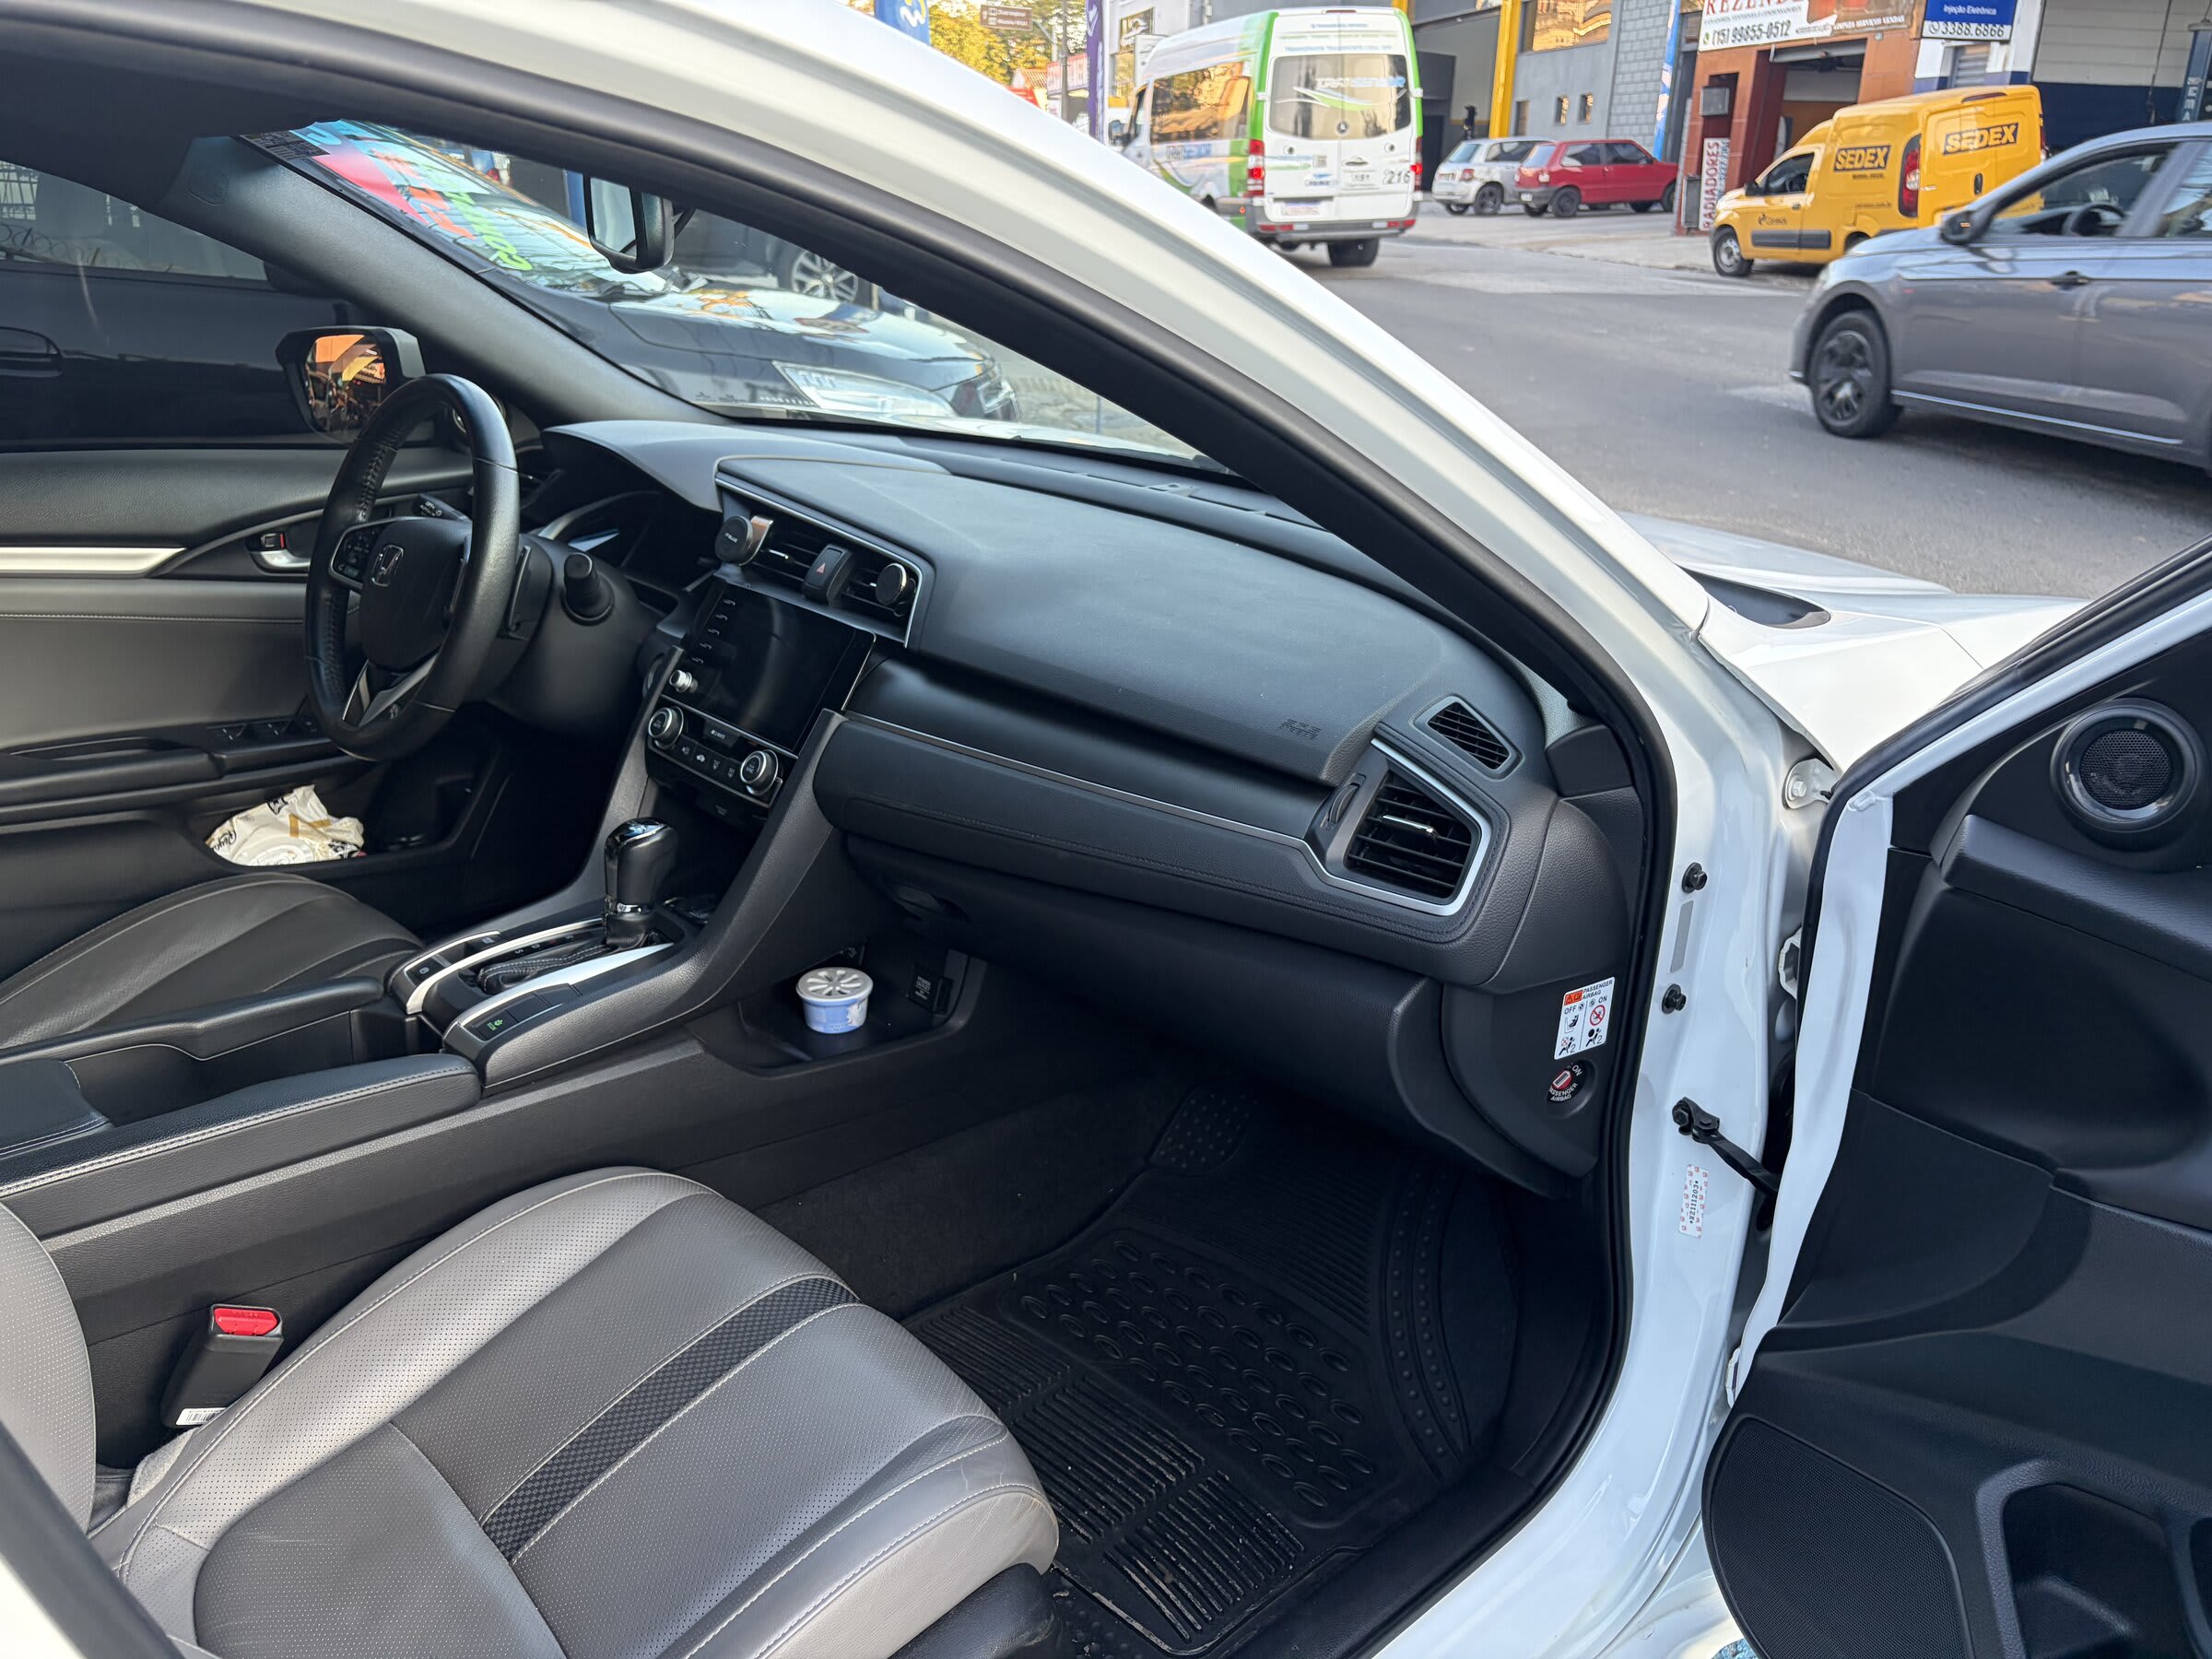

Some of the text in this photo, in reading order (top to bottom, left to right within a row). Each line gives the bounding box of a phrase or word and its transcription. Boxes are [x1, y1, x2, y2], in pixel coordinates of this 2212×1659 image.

[1946, 124, 2018, 152] SEDEX
[1836, 147, 1888, 170] SEDEX
[1583, 980, 1613, 993] PASSENGER
[1583, 990, 1602, 1000] AIRBAG
[1598, 995, 1607, 1004] ON
[1564, 1005, 1577, 1015] OFF
[1572, 1065, 1583, 1077] ON
